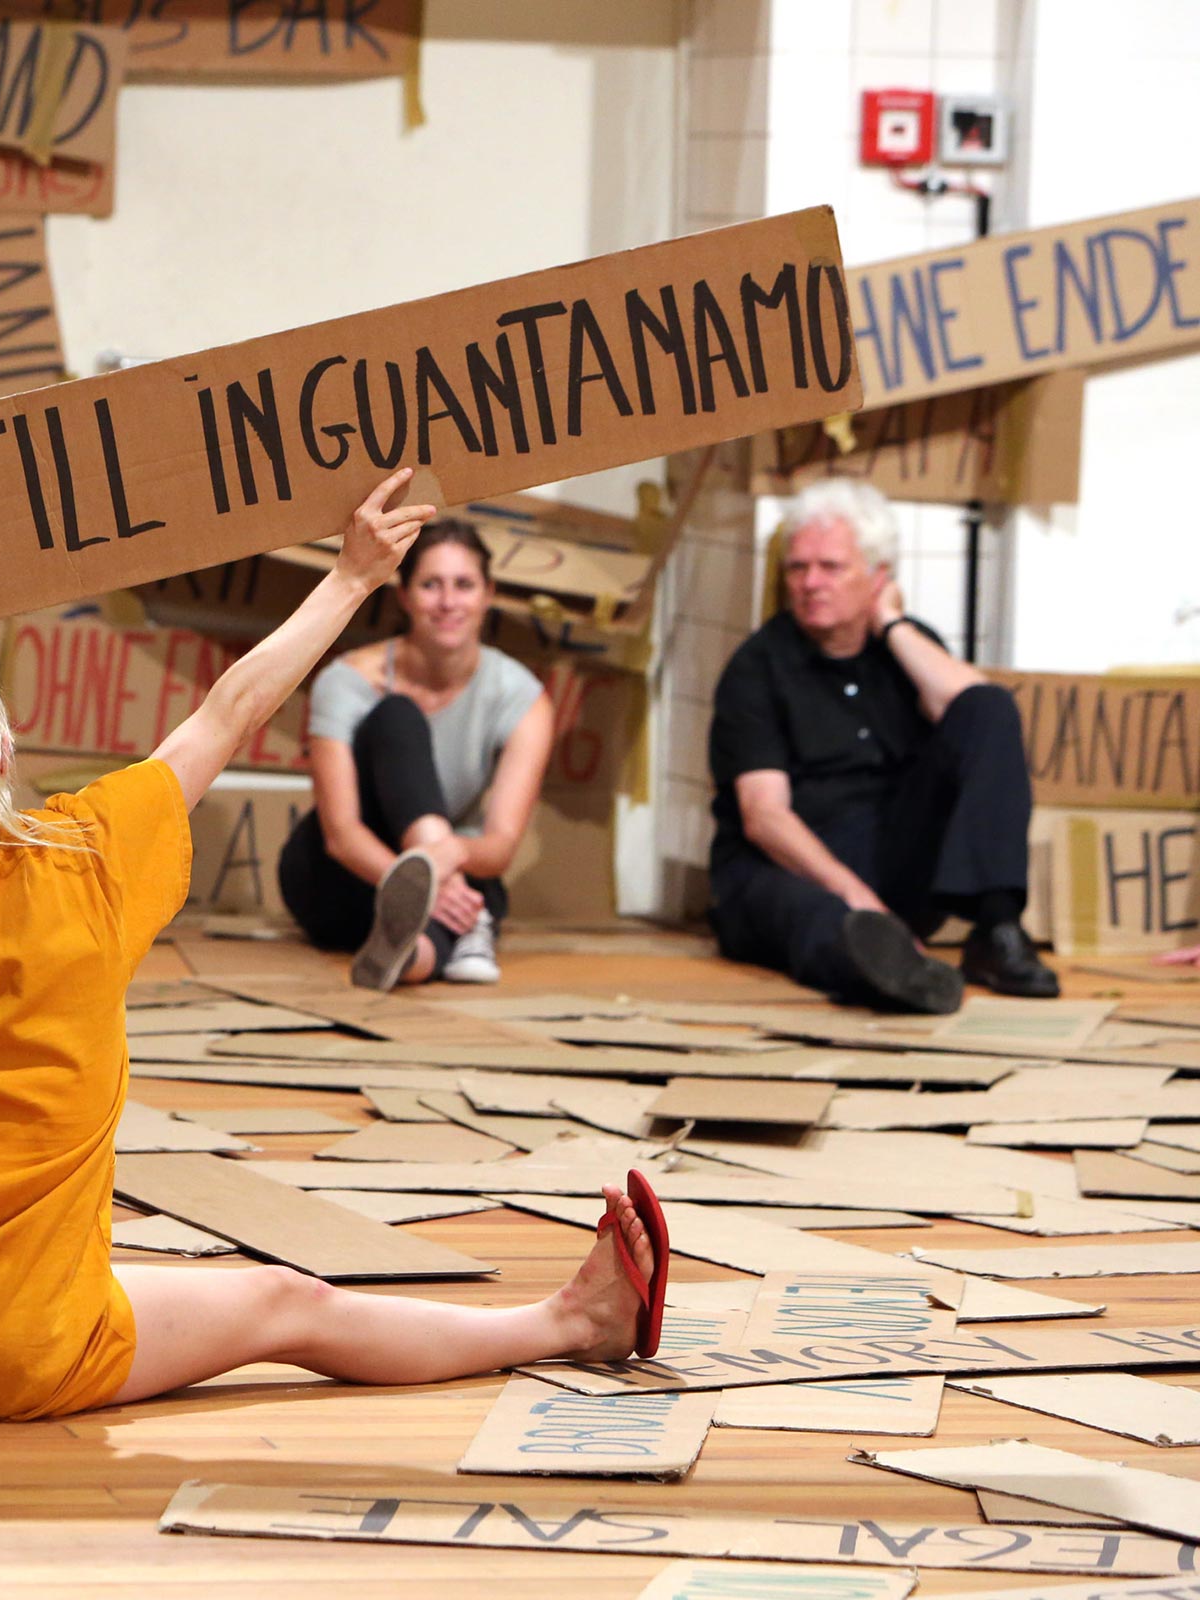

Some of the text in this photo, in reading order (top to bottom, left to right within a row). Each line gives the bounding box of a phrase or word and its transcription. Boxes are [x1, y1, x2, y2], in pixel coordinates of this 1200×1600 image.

[1003, 218, 1200, 361] ENDE
[11, 624, 155, 755] OHNE
[1012, 682, 1200, 795] UANTA
